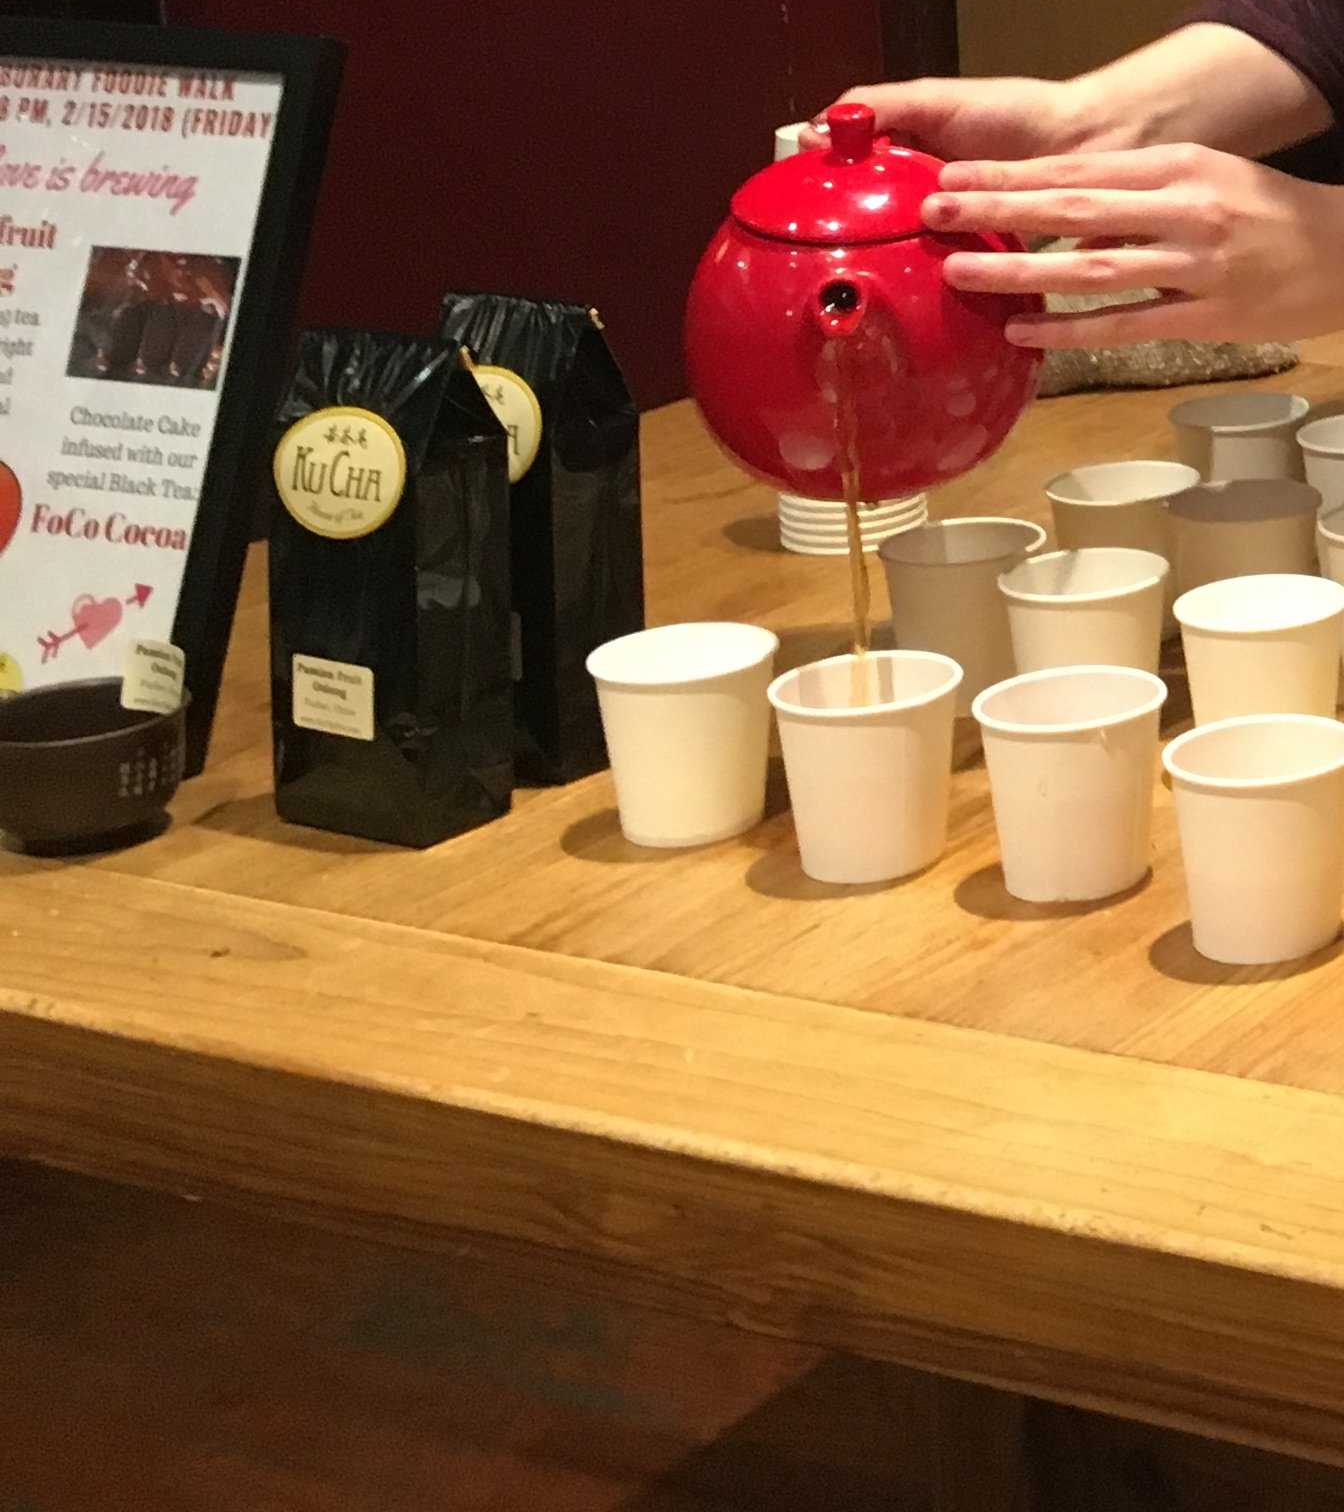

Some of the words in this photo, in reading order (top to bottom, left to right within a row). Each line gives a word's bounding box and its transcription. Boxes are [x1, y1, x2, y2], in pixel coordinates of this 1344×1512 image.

[91, 69, 167, 97] FOODIE
[177, 73, 236, 101] WALK
[61, 99, 175, 132] 2/15/2018
[46, 157, 75, 190] is
[80, 149, 199, 216] brewing
[70, 405, 154, 432] Chocolate
[158, 415, 201, 437] Cake
[61, 436, 123, 461] infused
[127, 445, 163, 466] with
[167, 452, 198, 468] our
[47, 470, 105, 491] special
[109, 473, 156, 496] Black
[31, 502, 99, 540] FoCo
[105, 512, 186, 551] Cocoa
